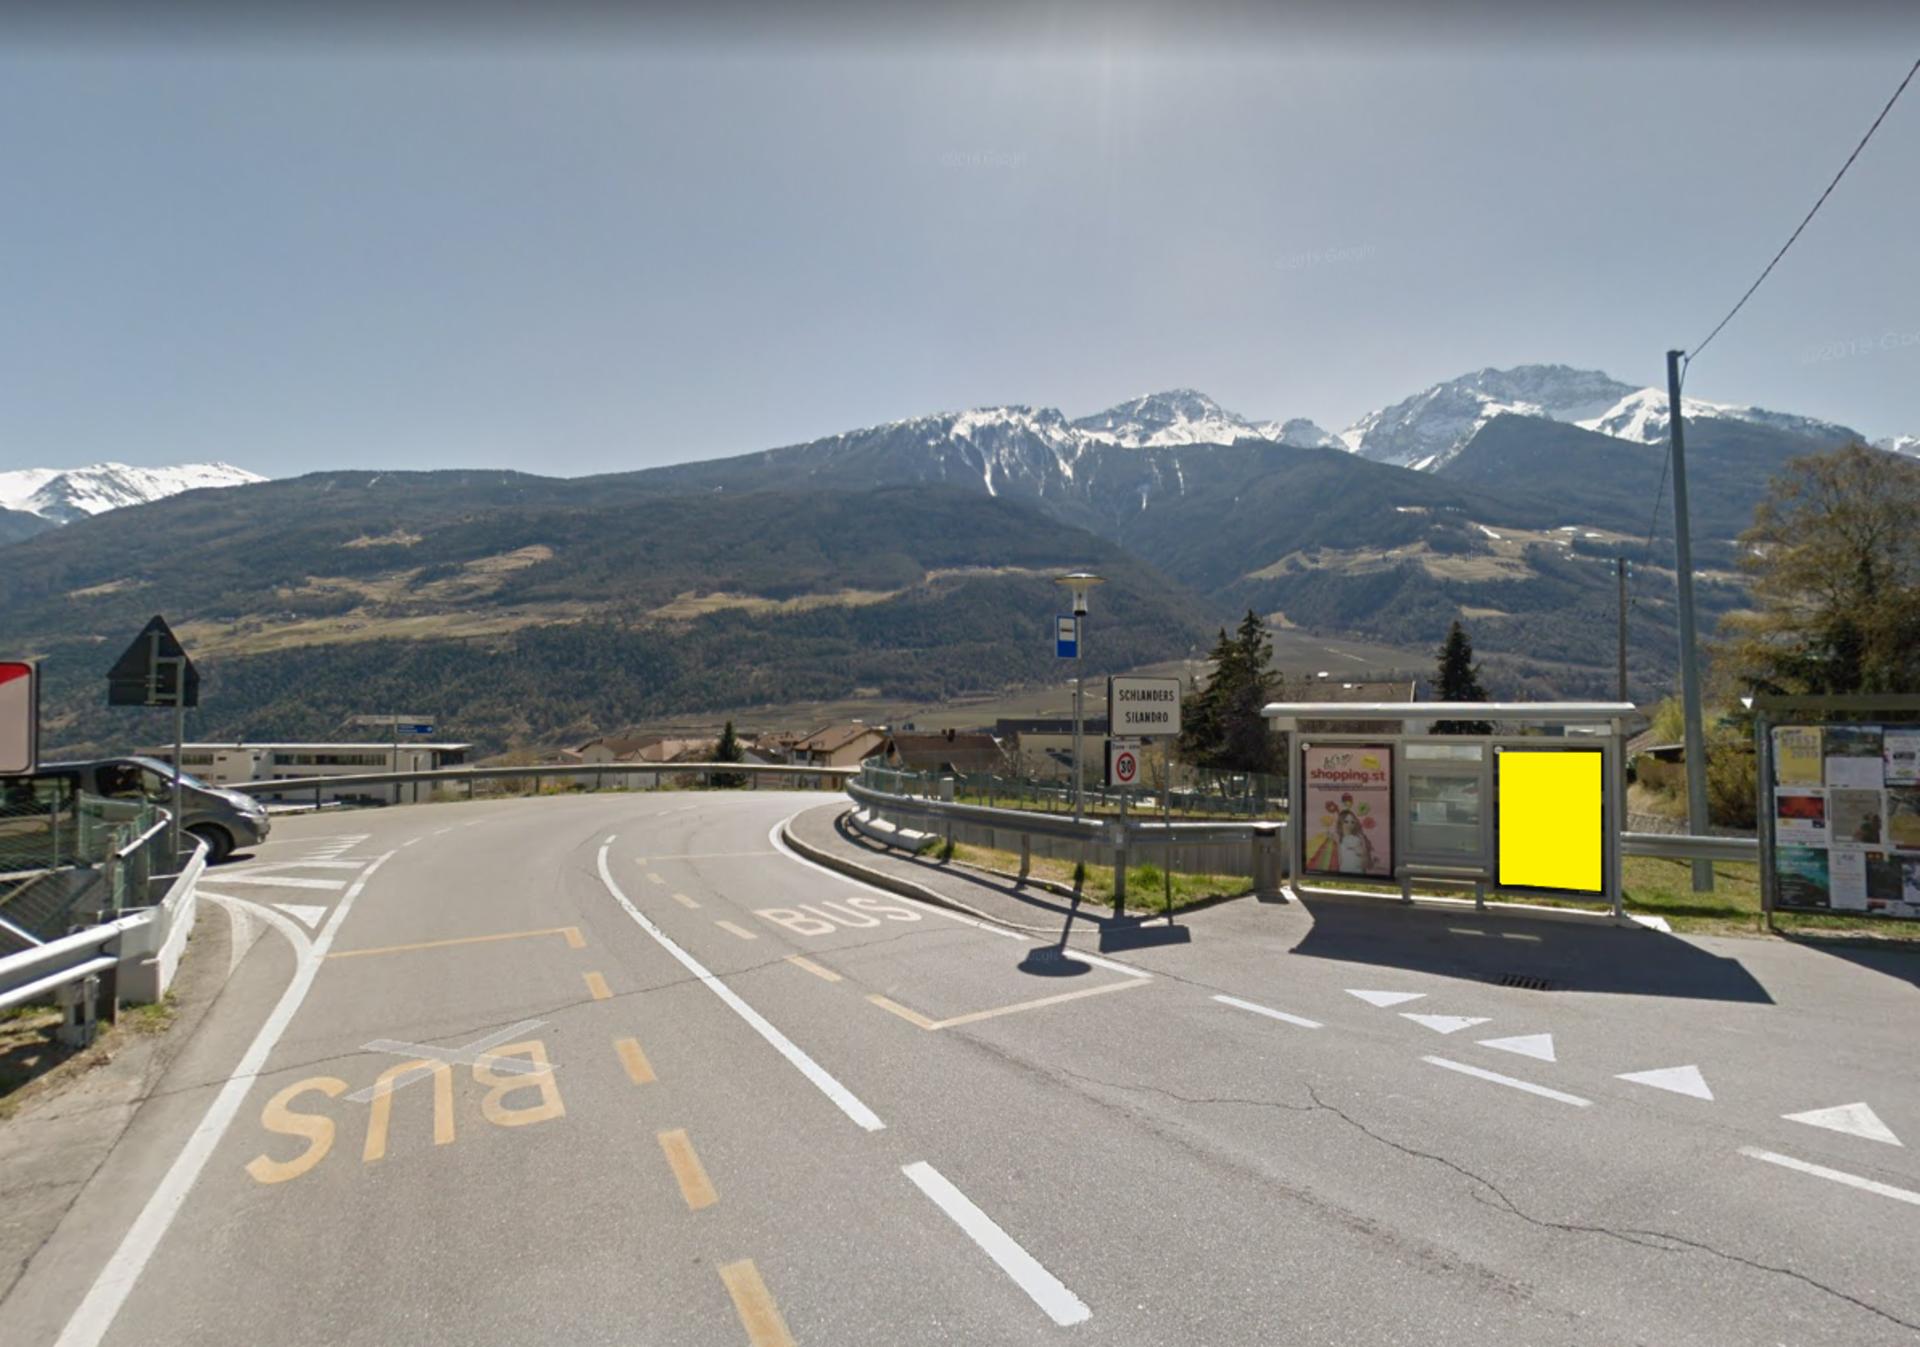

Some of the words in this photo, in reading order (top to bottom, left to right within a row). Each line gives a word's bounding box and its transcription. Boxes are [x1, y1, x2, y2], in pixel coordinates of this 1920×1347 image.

[1118, 688, 1175, 702] SCHLANDERS
[1125, 711, 1169, 724] SILANDRO
[1120, 759, 1133, 774] 30
[1311, 768, 1386, 783] shopping.st
[755, 896, 923, 938] BUS
[246, 1039, 566, 1185] BUS
